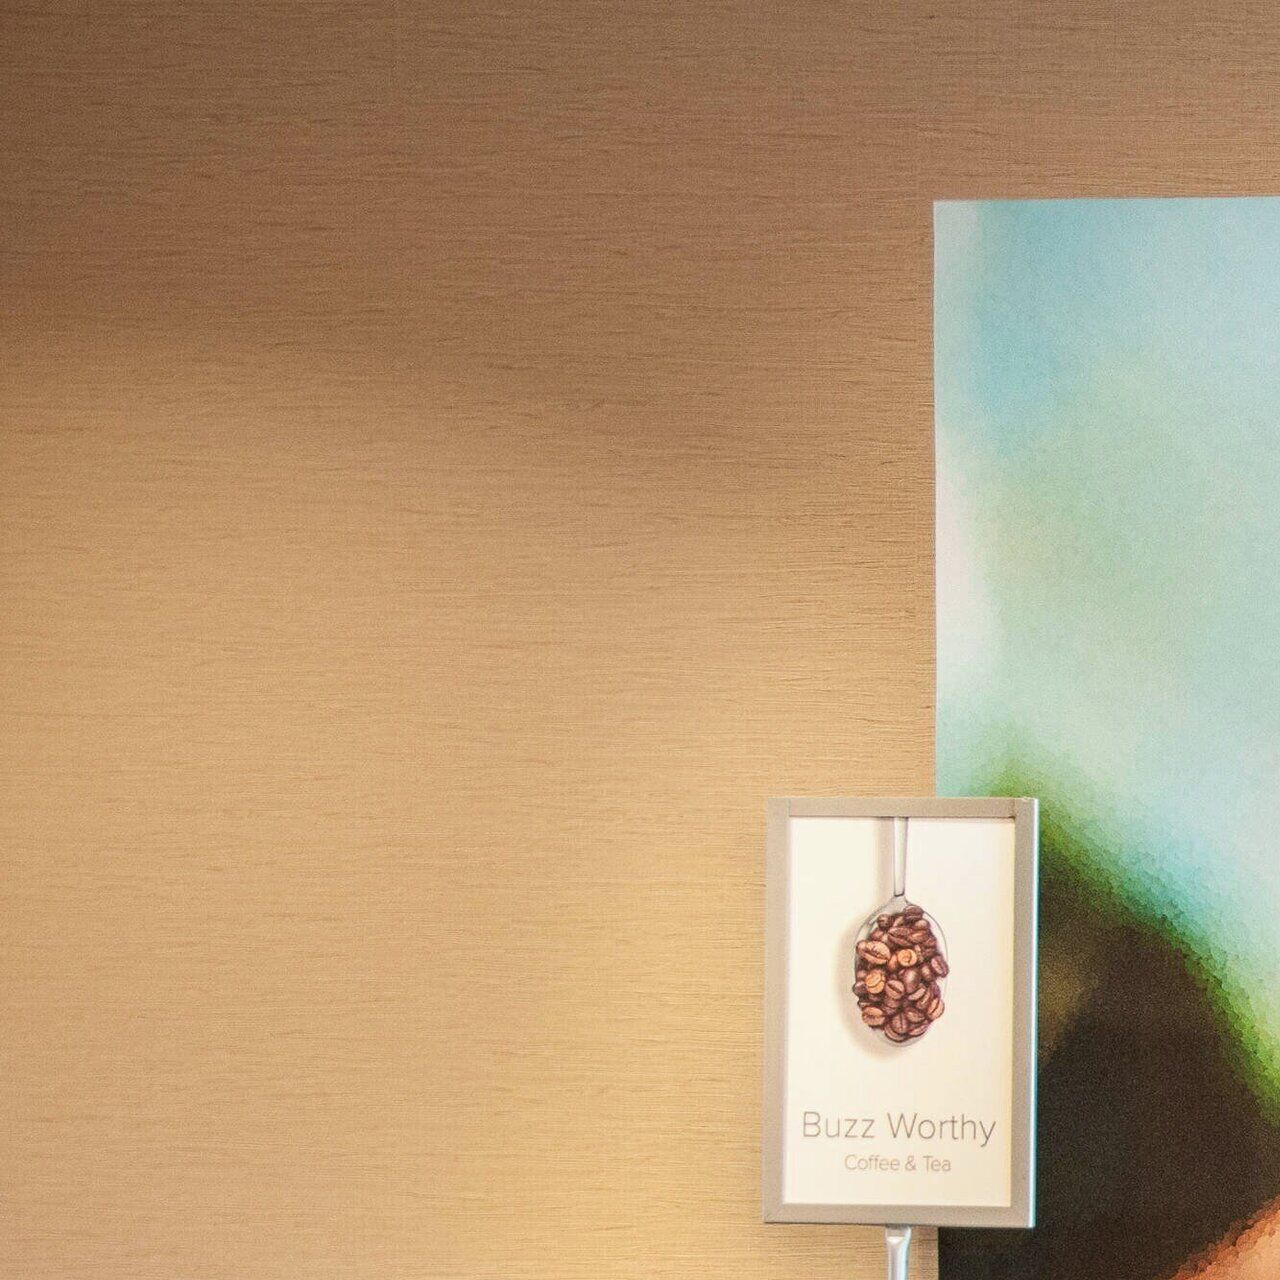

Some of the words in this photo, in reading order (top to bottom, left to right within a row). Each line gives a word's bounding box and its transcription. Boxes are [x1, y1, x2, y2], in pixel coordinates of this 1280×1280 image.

[801, 1111, 876, 1139] Buzz
[887, 1111, 997, 1148] Worthy
[844, 1153, 900, 1172] Coffee
[904, 1154, 917, 1172] &
[922, 1154, 951, 1172] Tea
